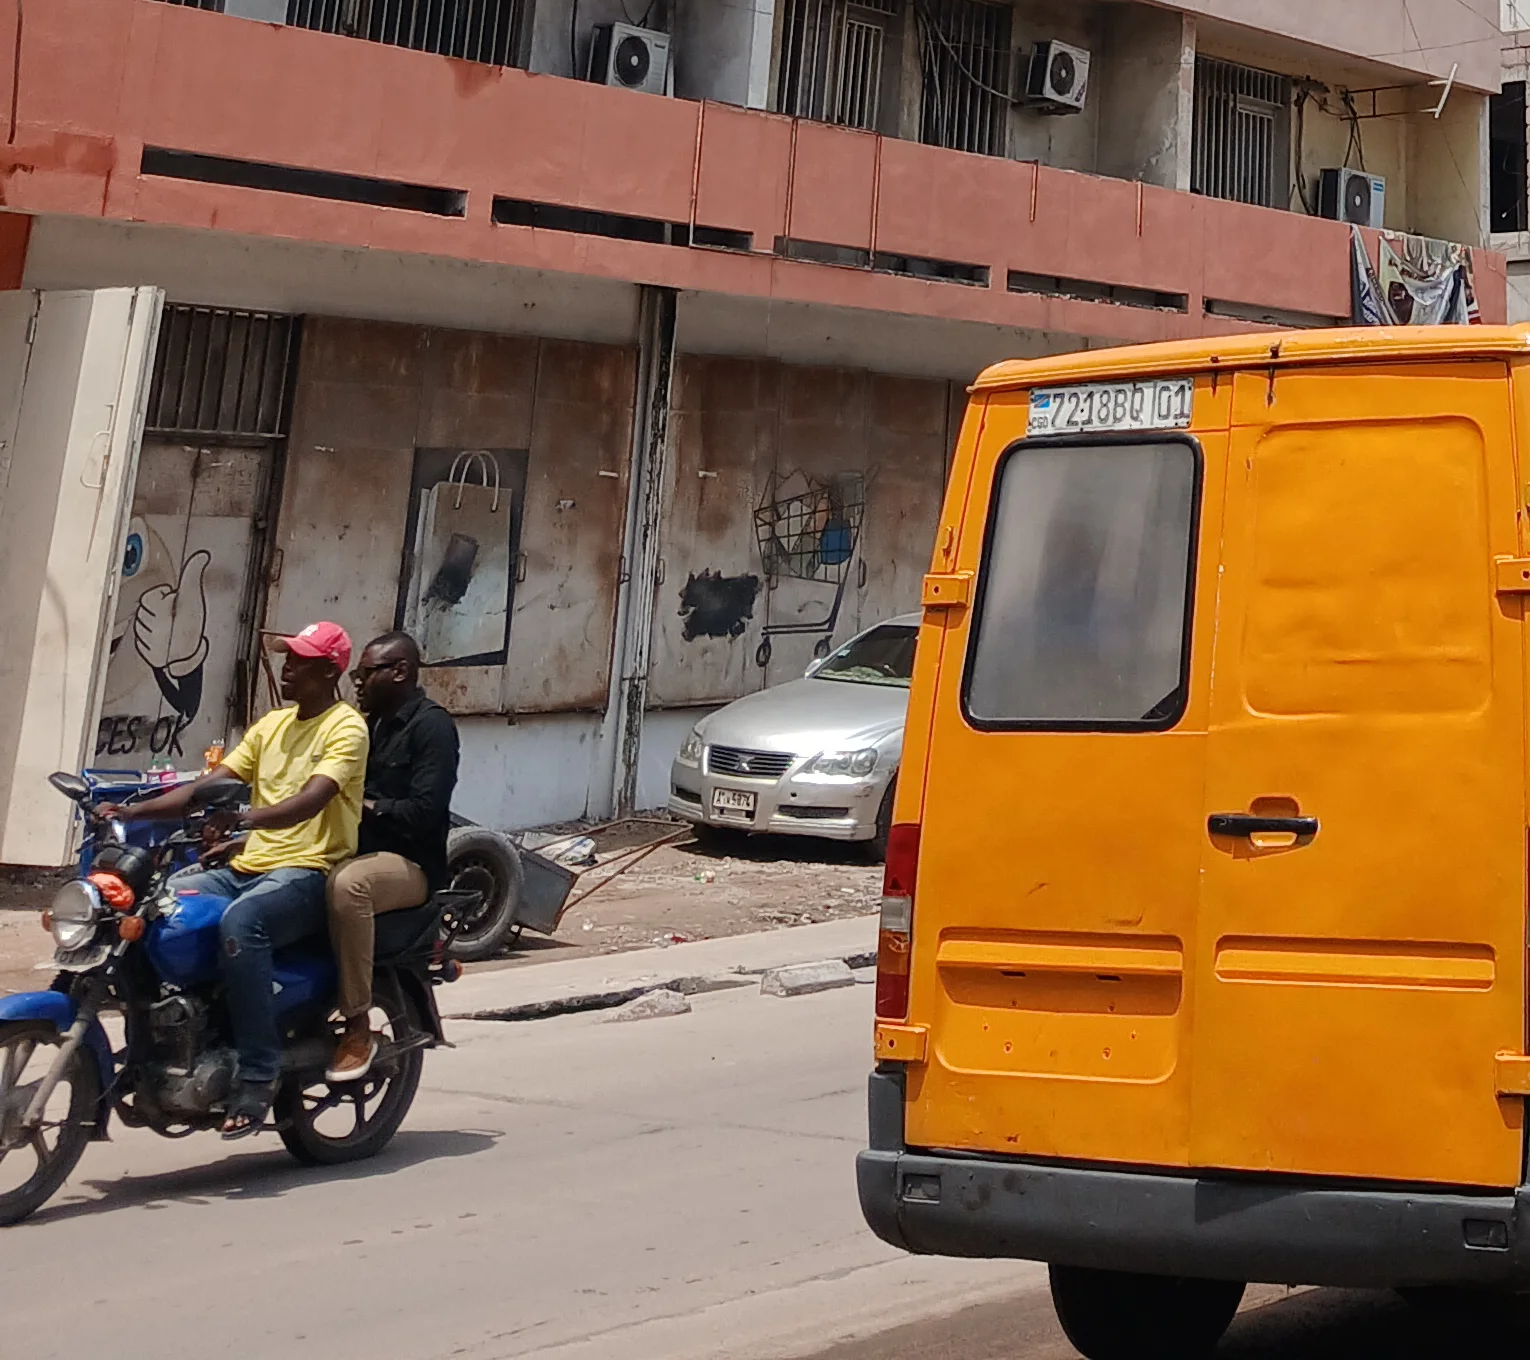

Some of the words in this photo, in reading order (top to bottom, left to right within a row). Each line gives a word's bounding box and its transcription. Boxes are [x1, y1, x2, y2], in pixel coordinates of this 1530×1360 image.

[1051, 387, 1144, 428] 7218BQ
[1158, 385, 1190, 420] 01
[150, 715, 194, 758] OK
